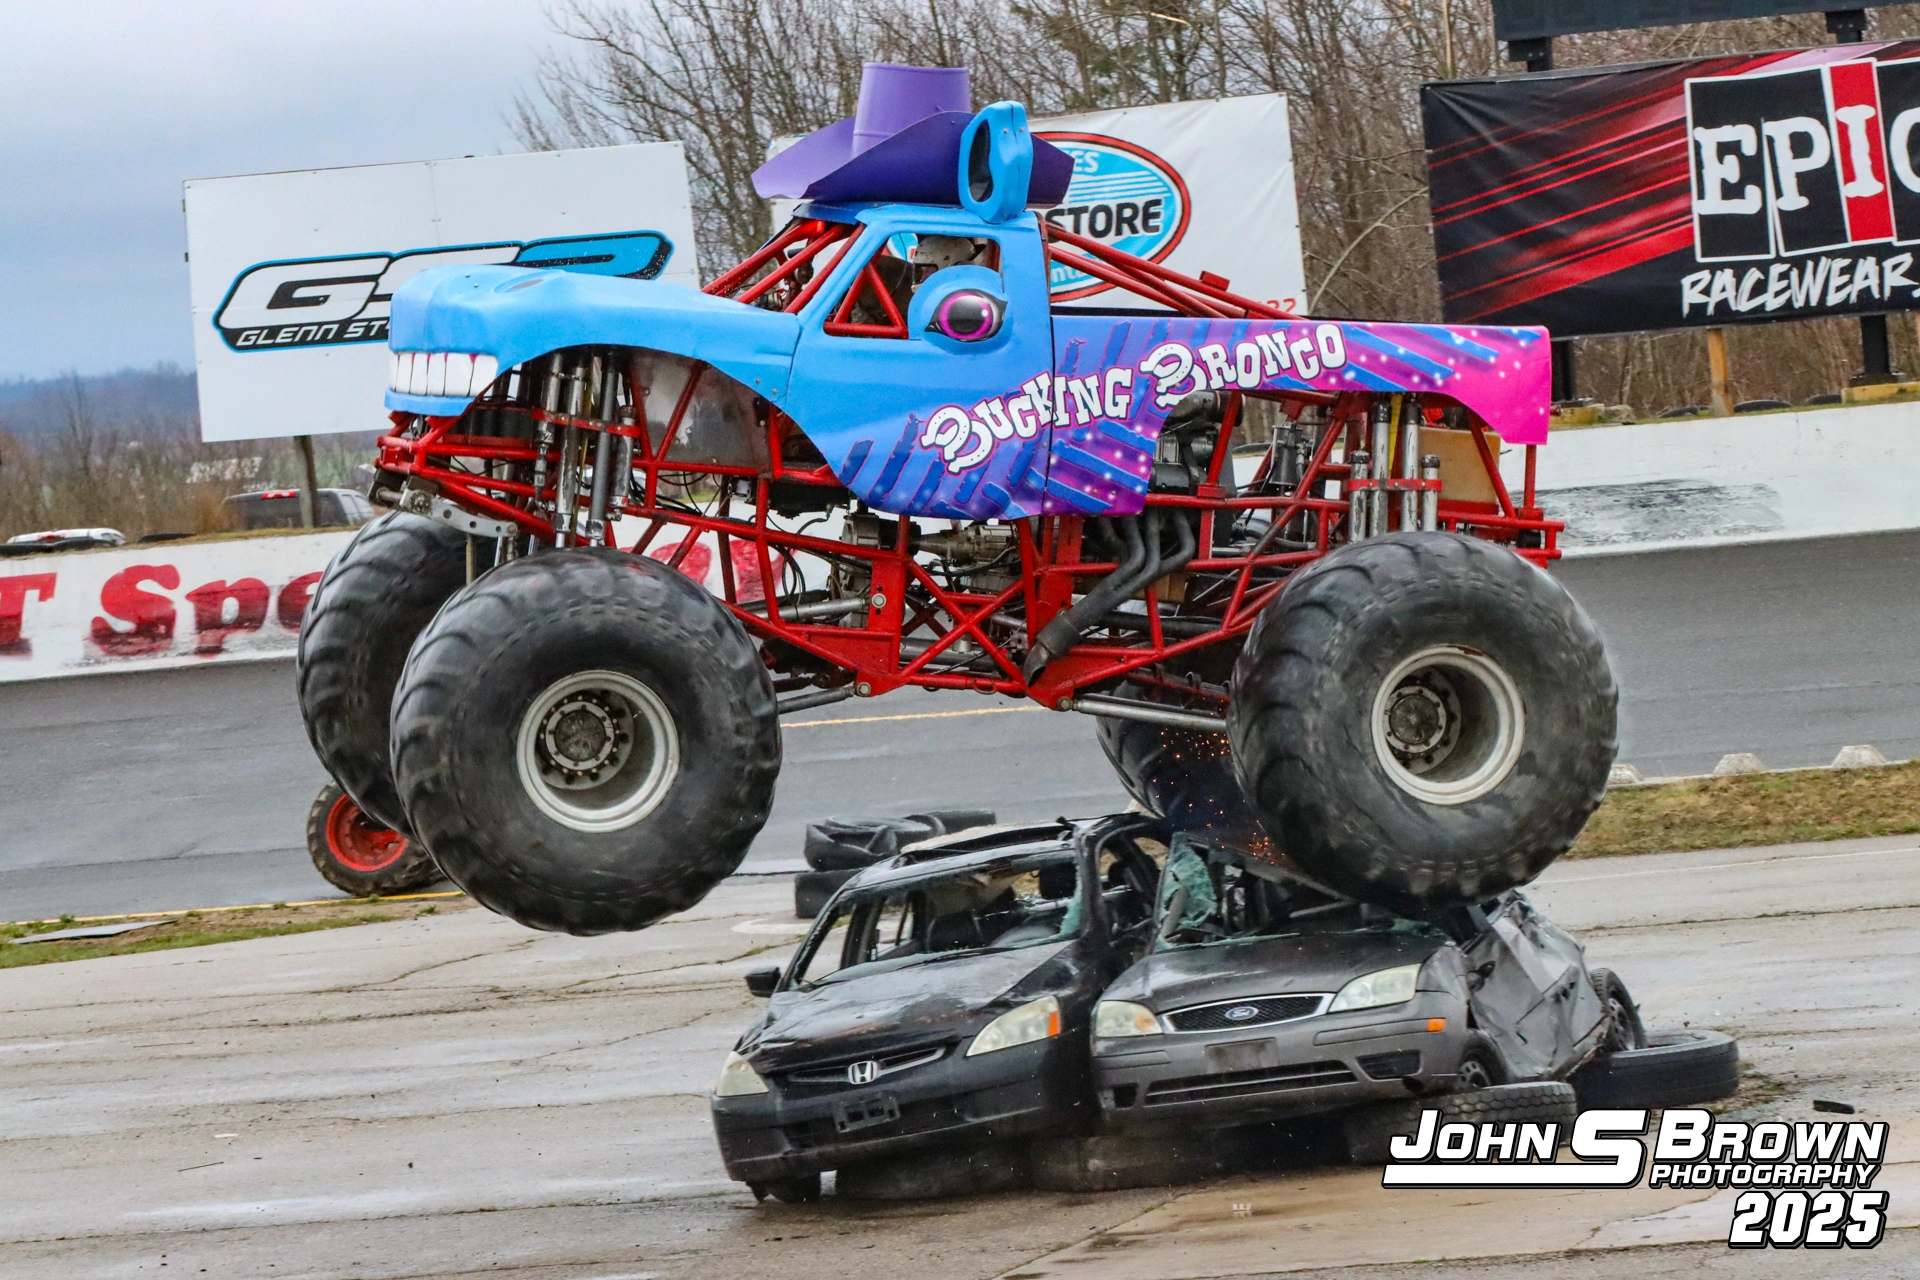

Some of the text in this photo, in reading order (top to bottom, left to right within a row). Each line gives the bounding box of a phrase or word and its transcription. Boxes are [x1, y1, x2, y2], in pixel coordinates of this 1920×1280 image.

[236, 319, 389, 346] GLENN ST
[920, 323, 1346, 474] BUCKING BRONCO
